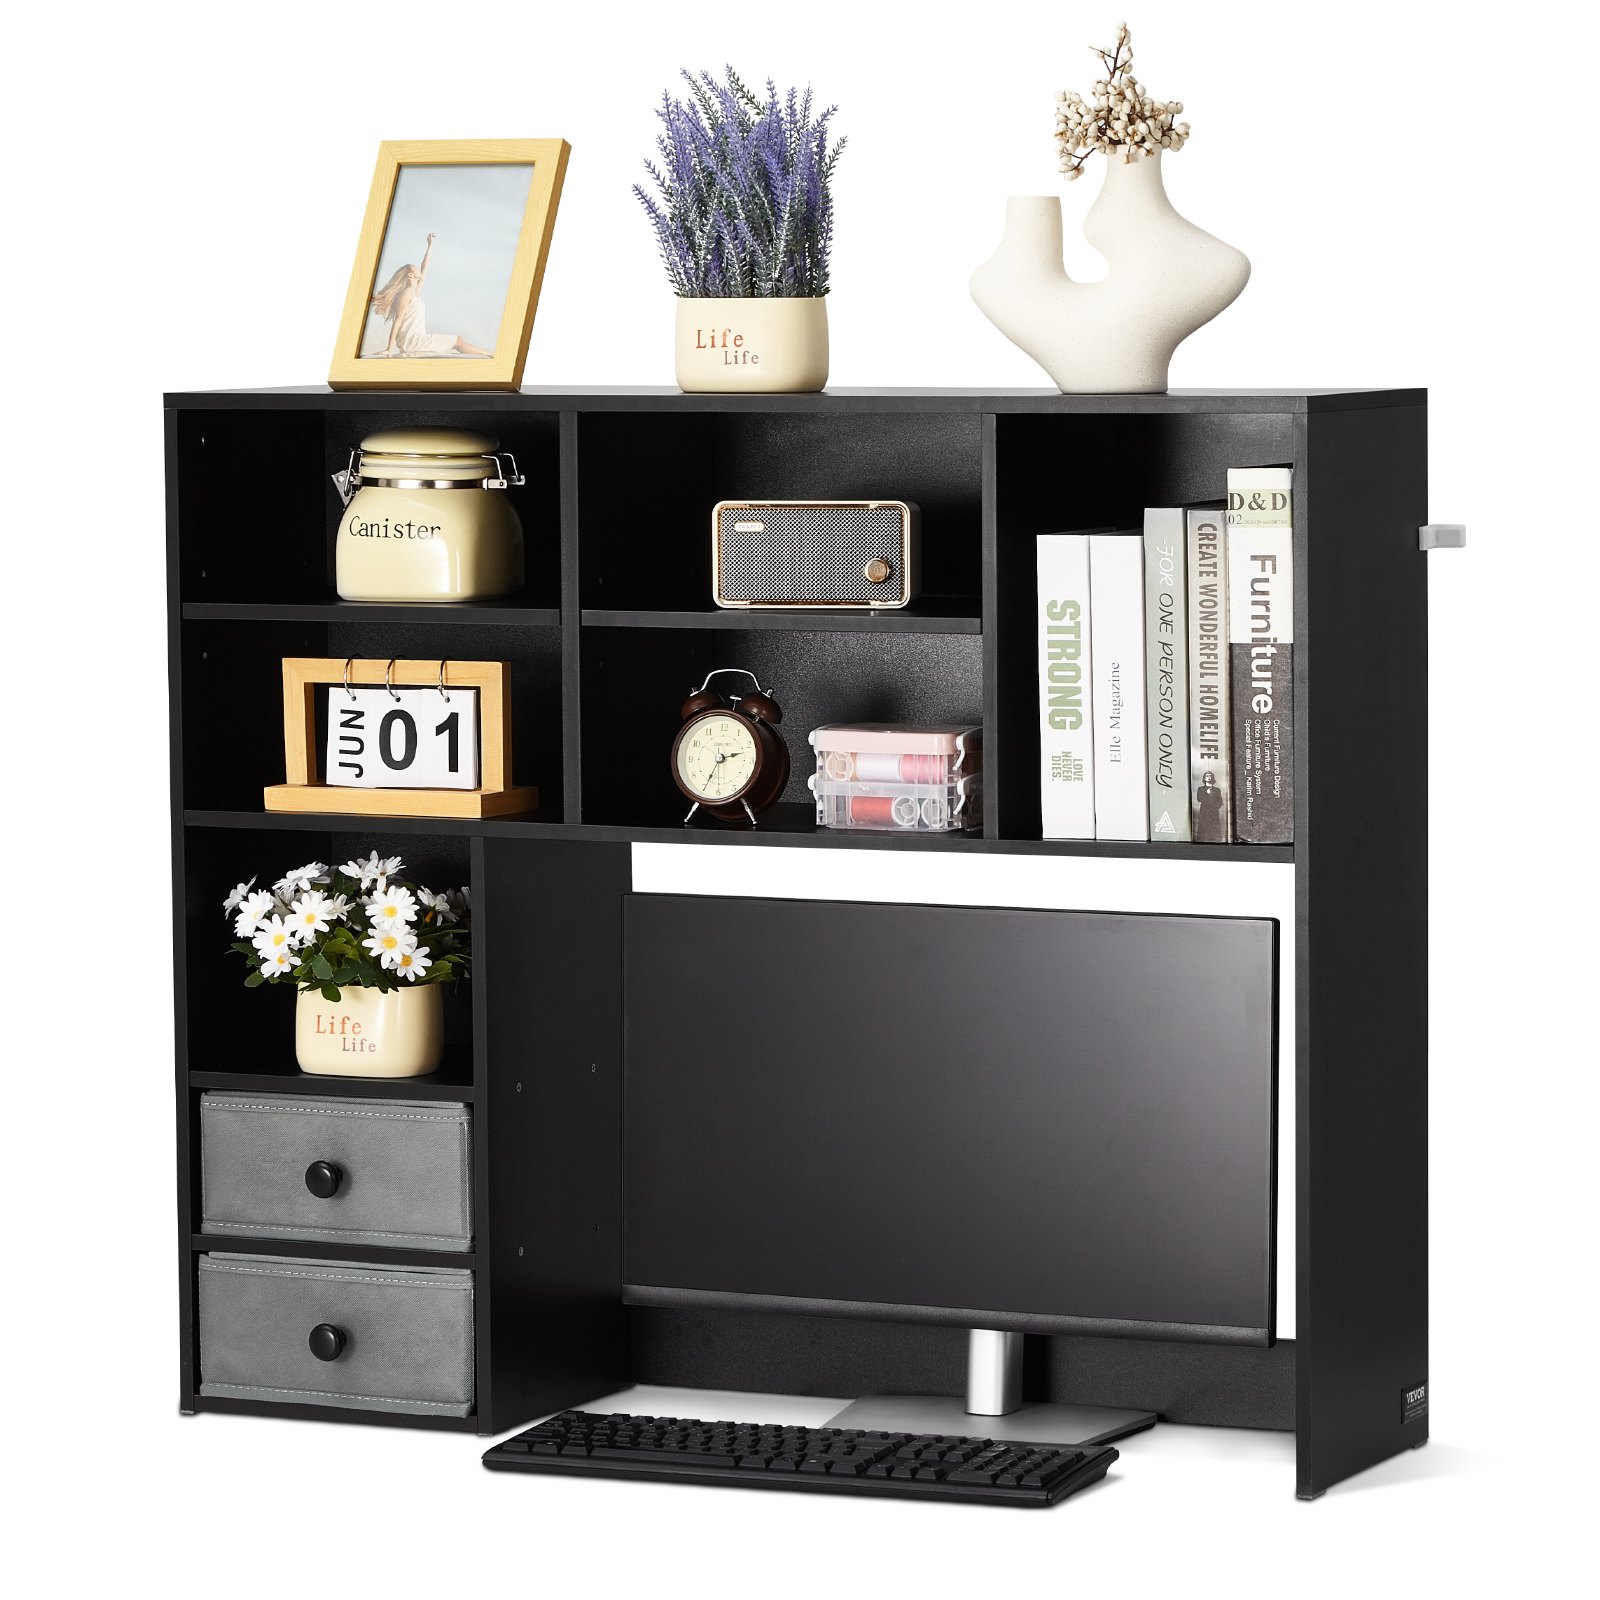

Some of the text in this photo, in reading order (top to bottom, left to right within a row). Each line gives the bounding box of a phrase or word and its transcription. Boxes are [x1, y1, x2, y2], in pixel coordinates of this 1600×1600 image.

[695, 328, 744, 349] Life
[723, 350, 760, 366] Life
[349, 515, 442, 540] Canister
[1158, 592, 1174, 635] ONE
[1197, 523, 1219, 760] CREATE WONDERFUL HOMELIFE
[1249, 554, 1278, 715] Furniture
[1046, 599, 1083, 731] STRONG
[1157, 640, 1174, 729] PERSON
[1108, 661, 1124, 764] Elle Magazine
[720, 724, 728, 732] 12
[1244, 719, 1252, 743] Special
[338, 708, 365, 779] JUN
[1254, 740, 1262, 769] Furniture
[1264, 742, 1272, 772] Furniture
[1051, 755, 1062, 782] DIES.
[1061, 751, 1073, 782] NEVER
[1072, 758, 1084, 782] LOVE
[1273, 745, 1281, 775] Furniture
[1254, 770, 1263, 795] System
[1272, 775, 1281, 799] Design
[315, 1014, 362, 1035] Life
[341, 1037, 377, 1053] Life
[1406, 1386, 1425, 1404] VEVOR
